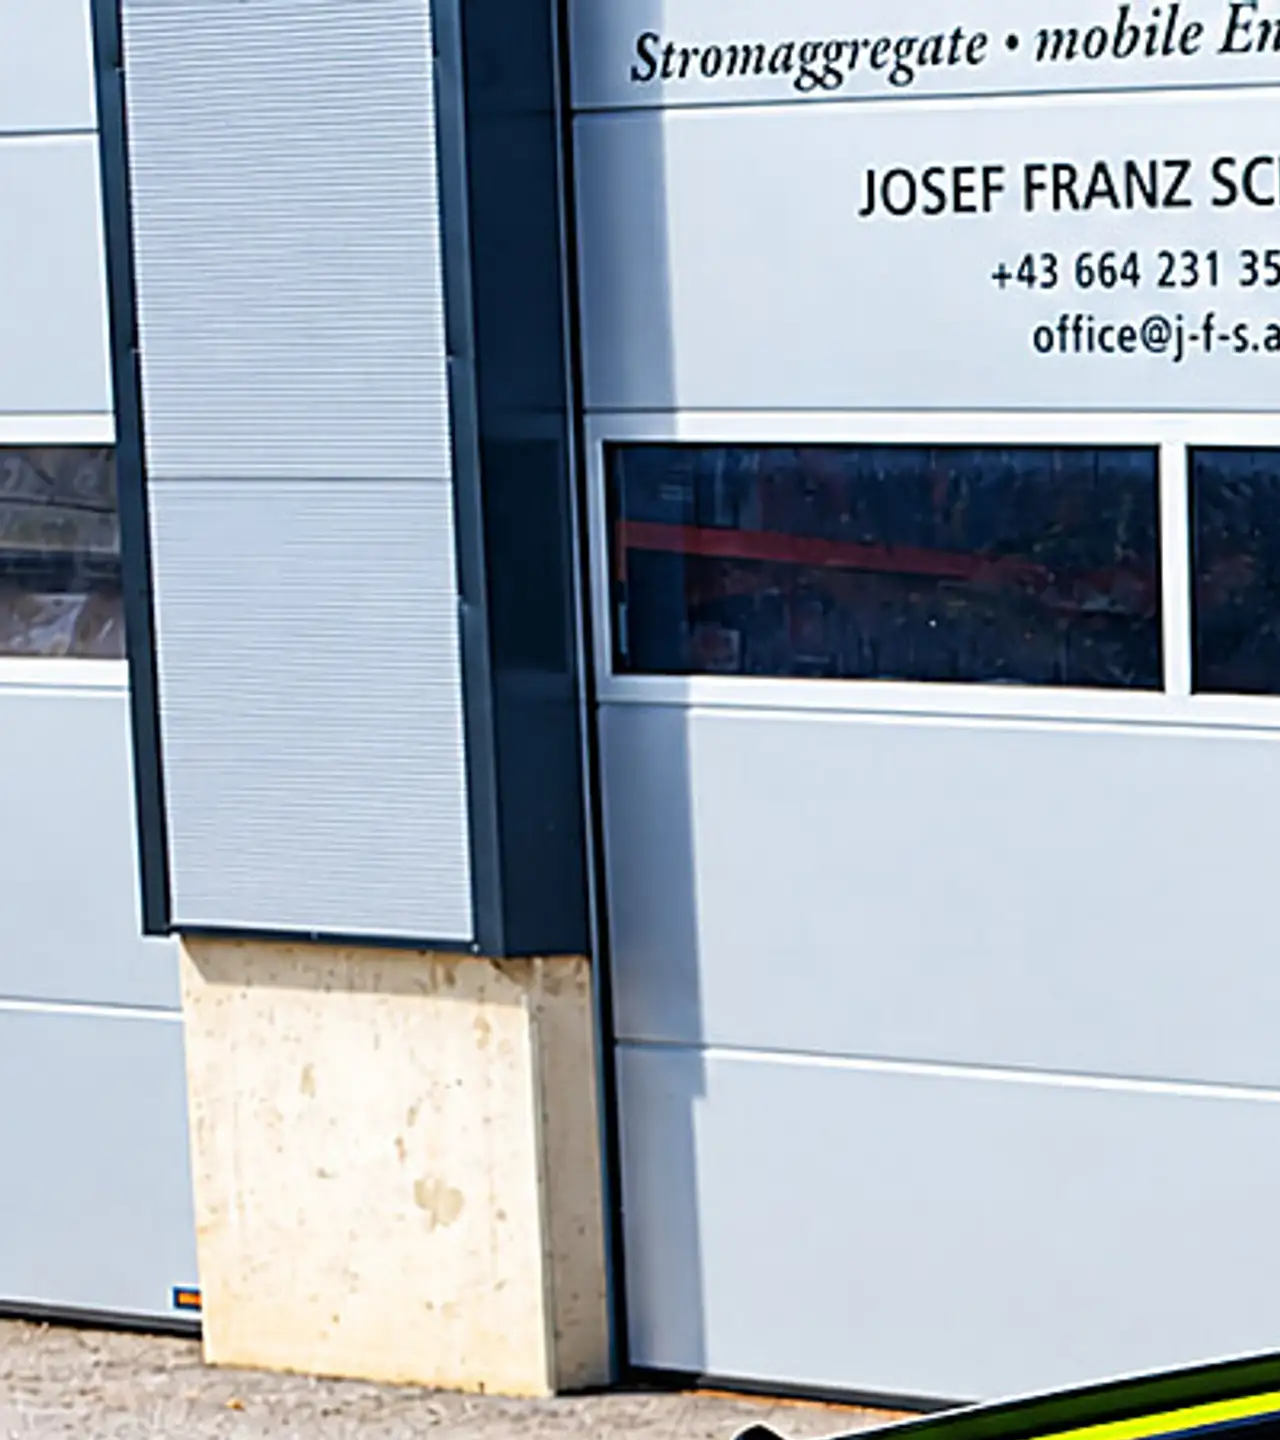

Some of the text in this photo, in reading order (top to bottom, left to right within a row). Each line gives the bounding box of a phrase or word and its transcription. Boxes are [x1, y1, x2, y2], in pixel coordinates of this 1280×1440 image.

[629, 27, 989, 92] Stromaggregate
[1035, 3, 1205, 62] mobile
[857, 164, 1005, 218] JOSEF
[1023, 158, 1193, 213] FRANZ
[990, 251, 1059, 290] +43
[1074, 250, 1142, 290] 664
[1156, 248, 1219, 289] 231
